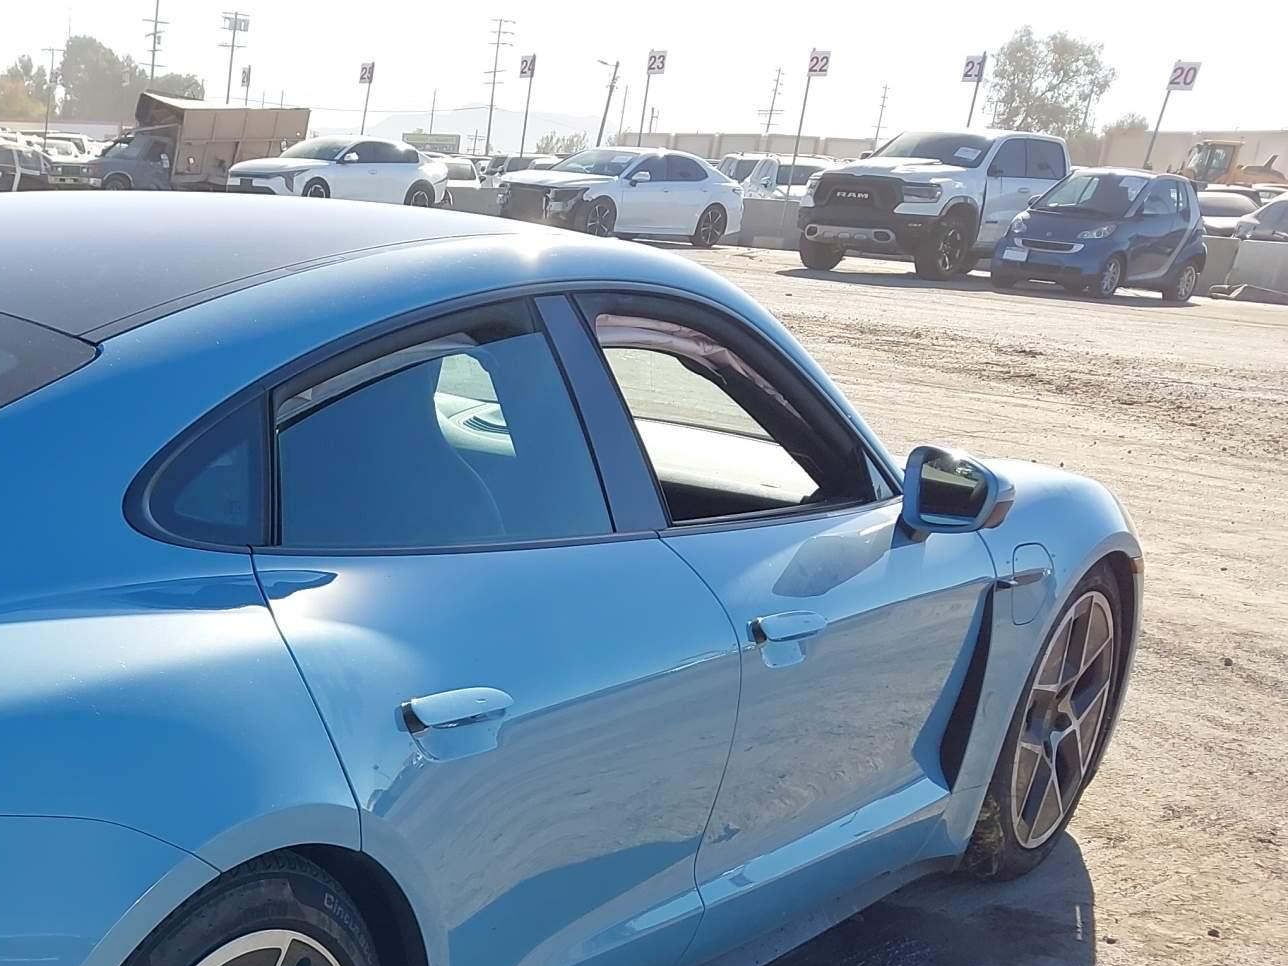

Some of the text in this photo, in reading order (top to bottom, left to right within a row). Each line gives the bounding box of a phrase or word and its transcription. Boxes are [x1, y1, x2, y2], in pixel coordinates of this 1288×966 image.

[520, 59, 535, 74] 24
[648, 55, 665, 70] 23
[808, 55, 829, 72] 22
[963, 60, 984, 77] 21
[1169, 66, 1197, 85] 20
[837, 191, 869, 199] RAM
